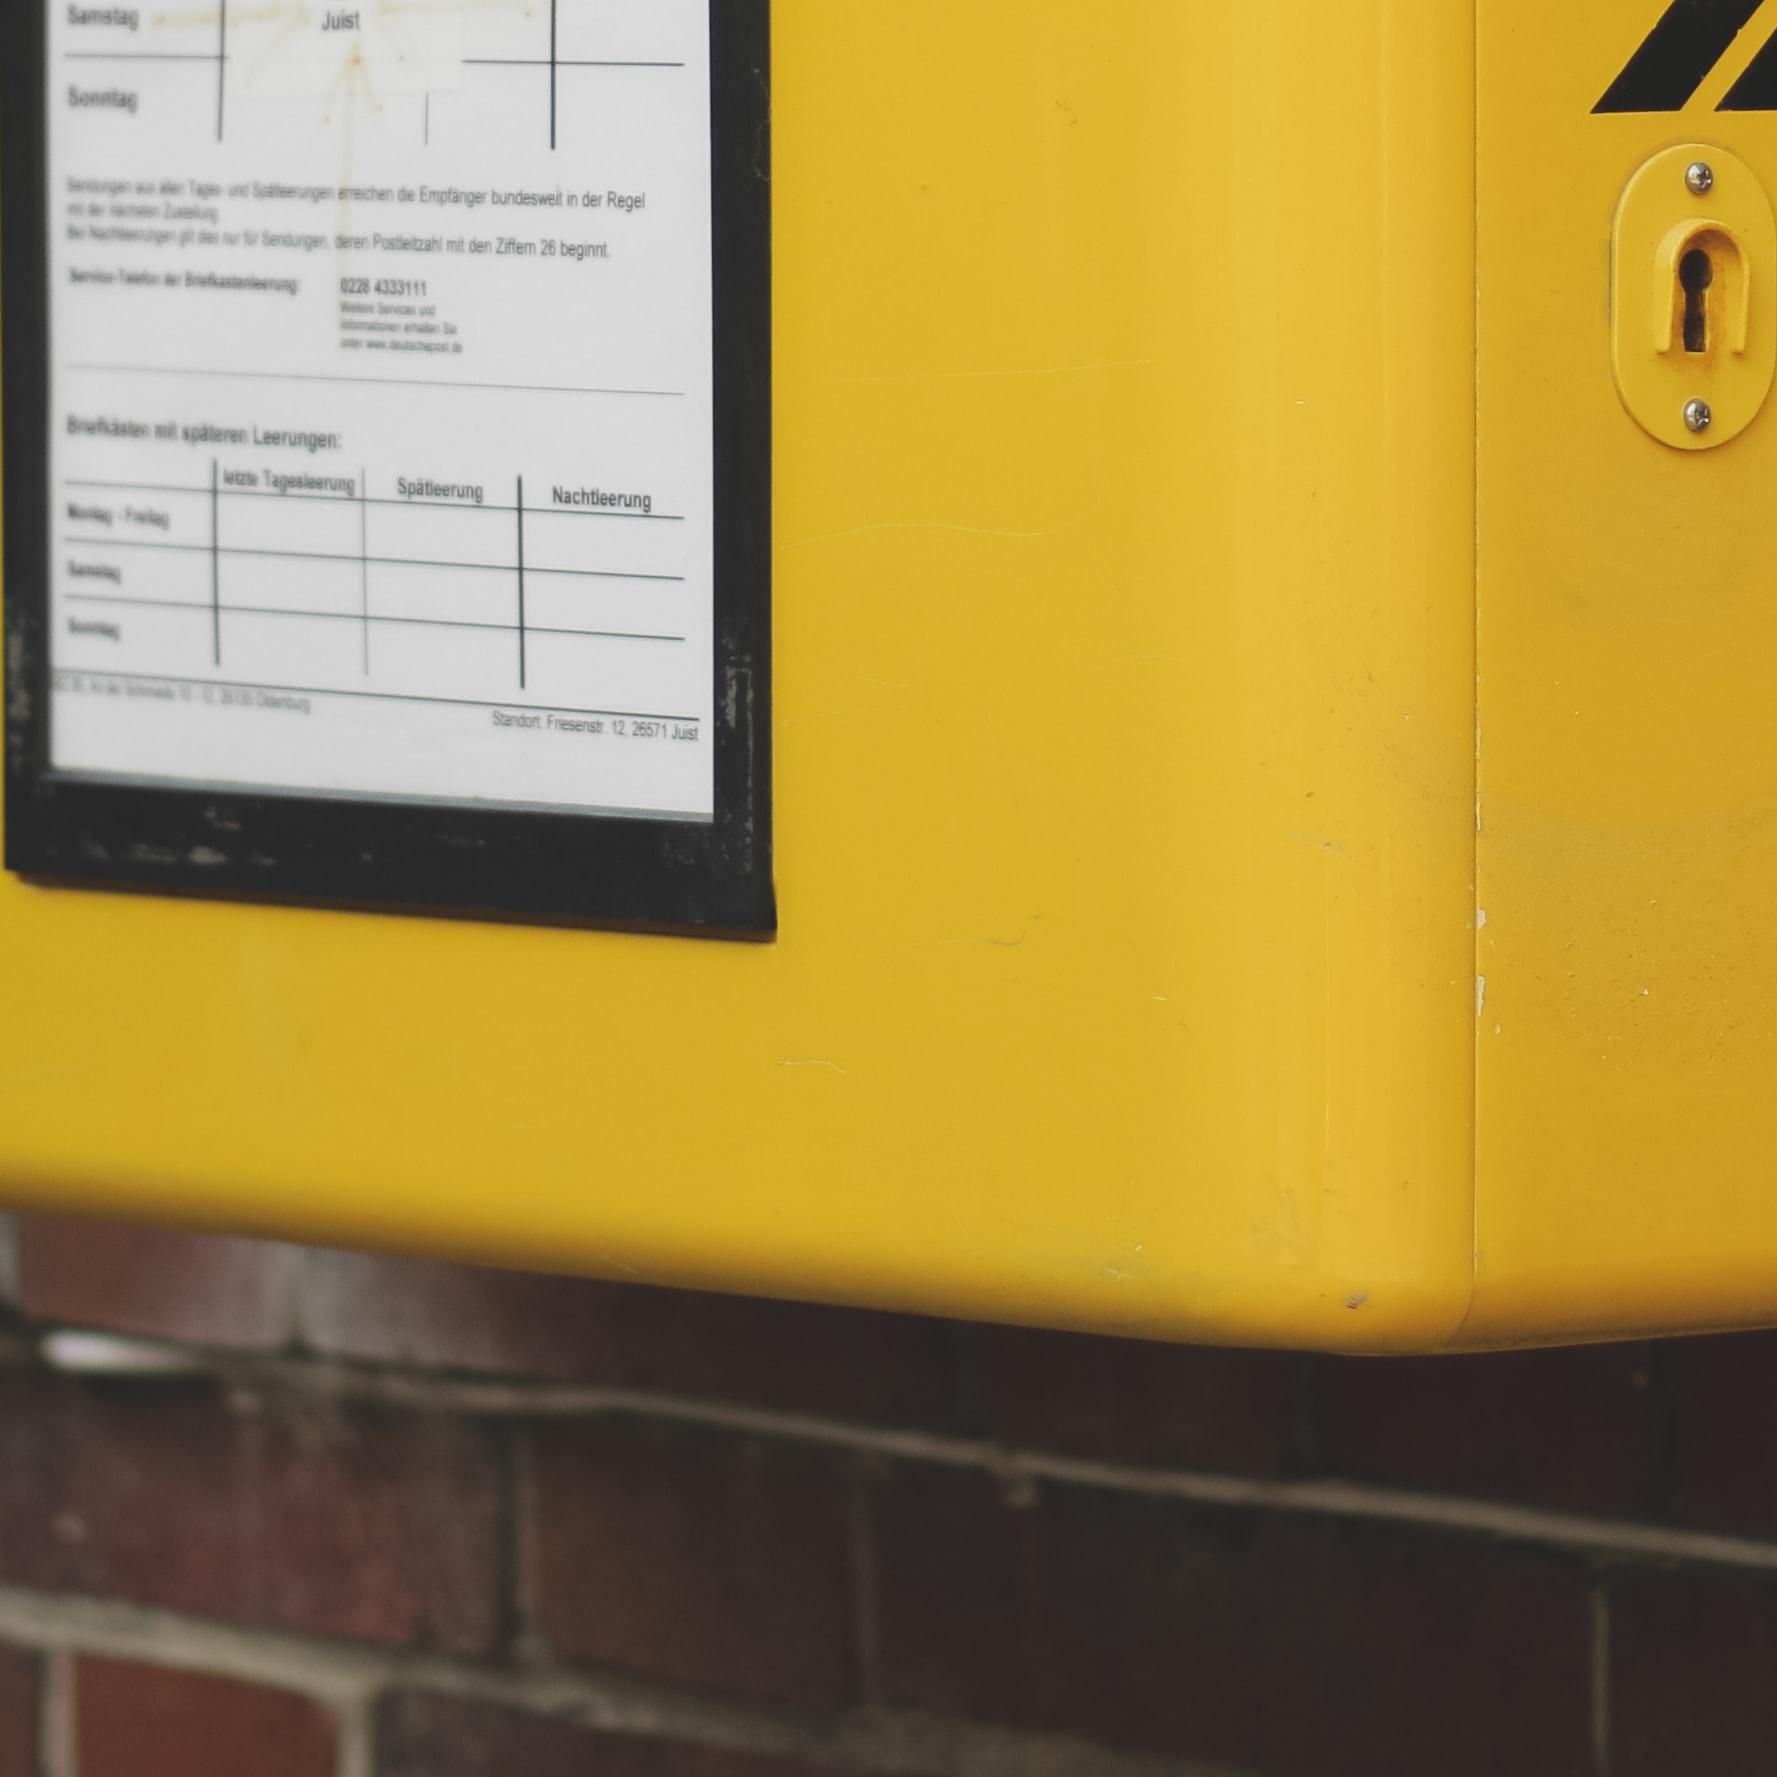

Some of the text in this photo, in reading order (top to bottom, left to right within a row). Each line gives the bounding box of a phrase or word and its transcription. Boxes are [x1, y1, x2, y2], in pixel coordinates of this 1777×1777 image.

[67, 3, 140, 31] Samstag
[322, 9, 361, 31] Juist
[67, 83, 138, 113] Sonntag
[398, 185, 414, 203] die
[419, 185, 488, 208] Empfänger
[491, 187, 563, 207] bundesweit
[567, 189, 578, 207] in
[582, 189, 604, 208] der
[607, 190, 646, 212] Regel
[373, 233, 443, 252] Postleitzahl
[446, 236, 465, 253] mit
[469, 236, 492, 254] den
[496, 237, 537, 256] Ziffern
[540, 239, 557, 257] 26
[560, 240, 611, 261] beginnt.
[339, 277, 428, 297] 0228 4333111
[154, 420, 179, 441] mit
[182, 422, 247, 448] späteren
[263, 469, 356, 497] Tagesleerung
[397, 476, 484, 504] Spätleerung
[552, 486, 652, 512] Nachtleerung
[632, 720, 668, 740] 26571
[671, 724, 700, 742] Juist
